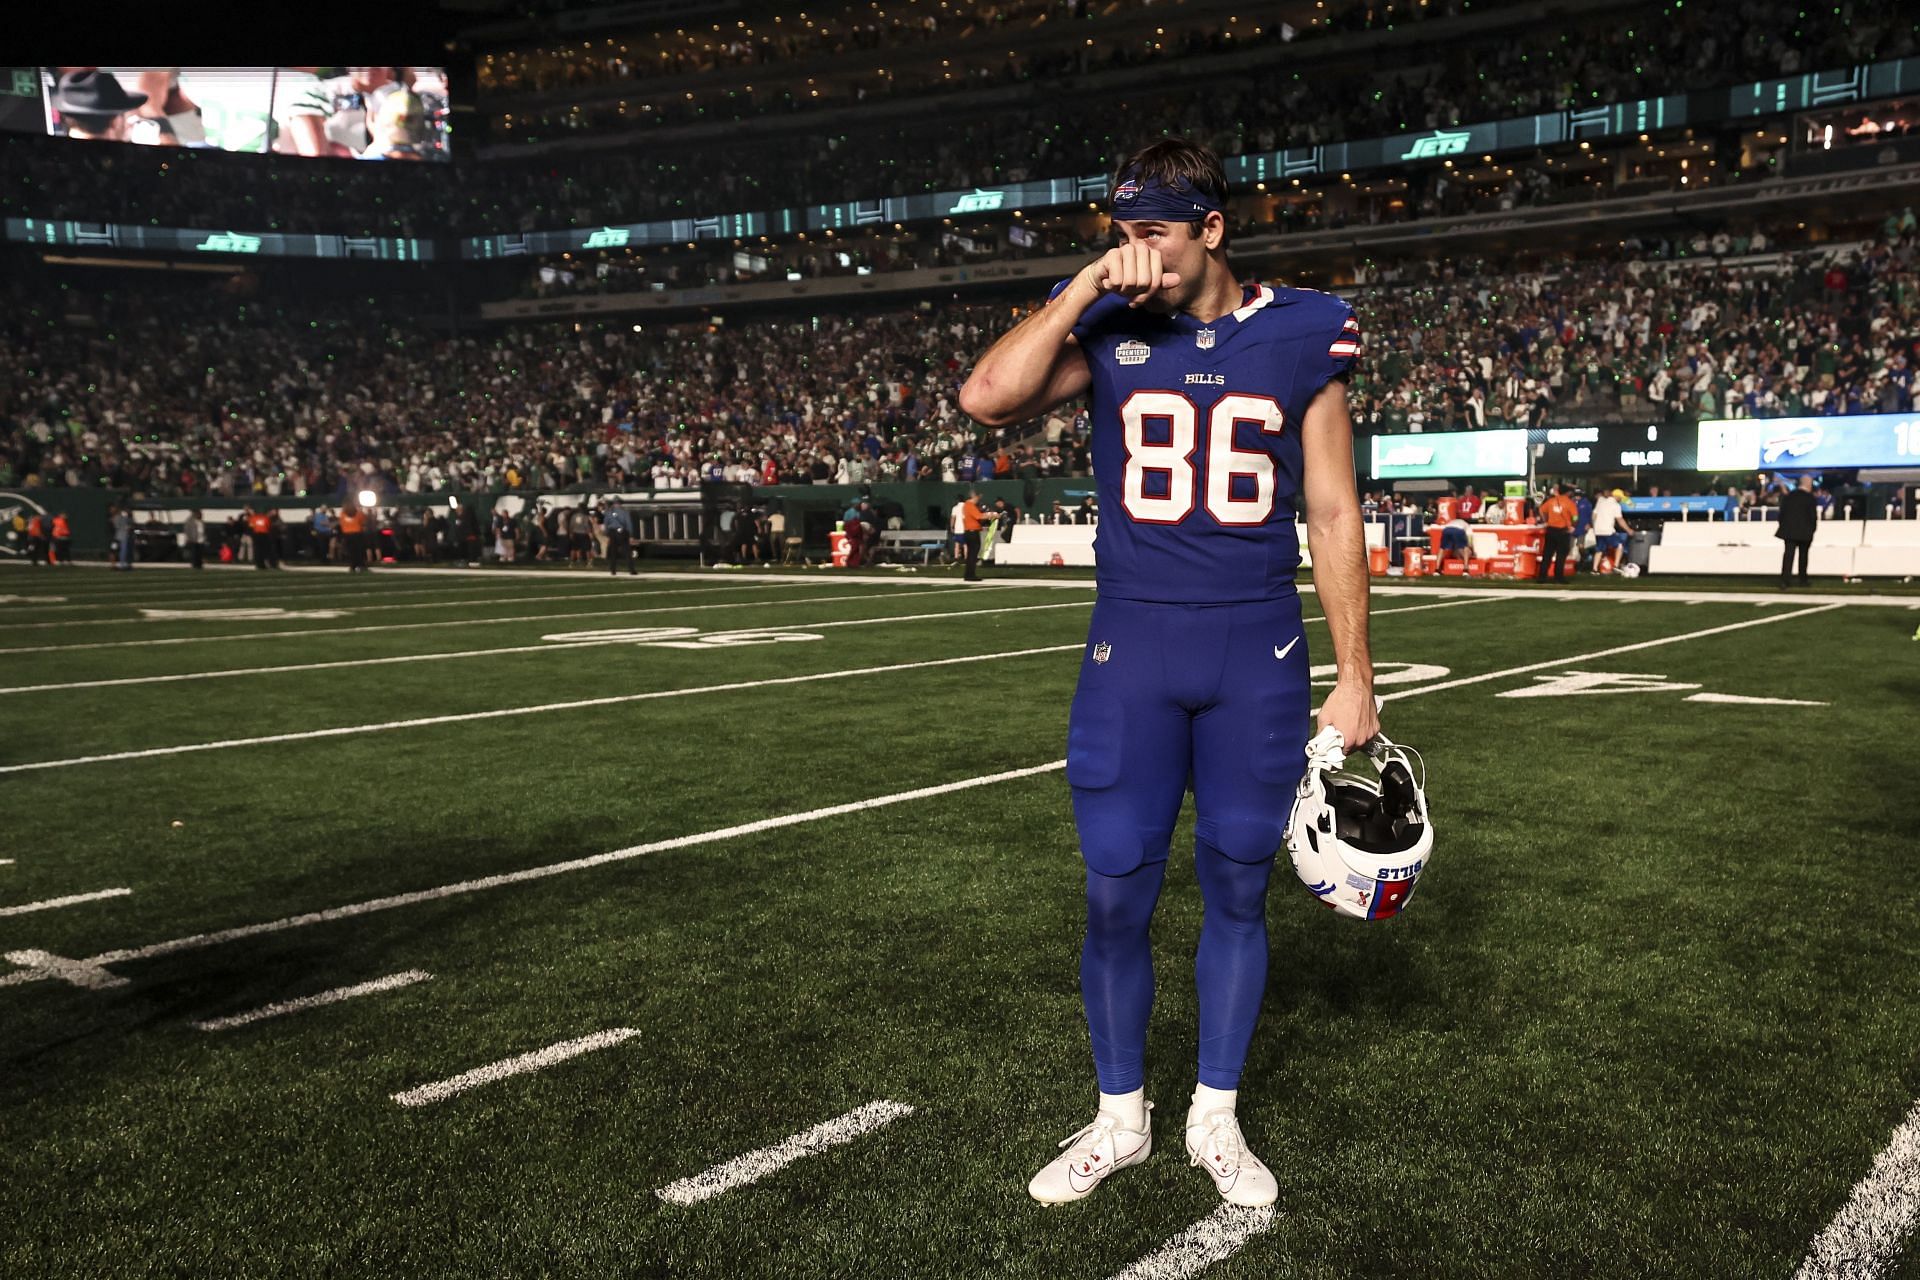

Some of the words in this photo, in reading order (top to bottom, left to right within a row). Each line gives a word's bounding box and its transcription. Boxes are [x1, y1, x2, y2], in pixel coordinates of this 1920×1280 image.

[1401, 130, 1471, 160] JETS
[950, 188, 1004, 214] JETS
[196, 231, 261, 253] JETS
[582, 226, 630, 248] JETS
[1184, 374, 1225, 386] BILLS
[1120, 389, 1284, 526] 86
[1377, 859, 1422, 880] BILLS
